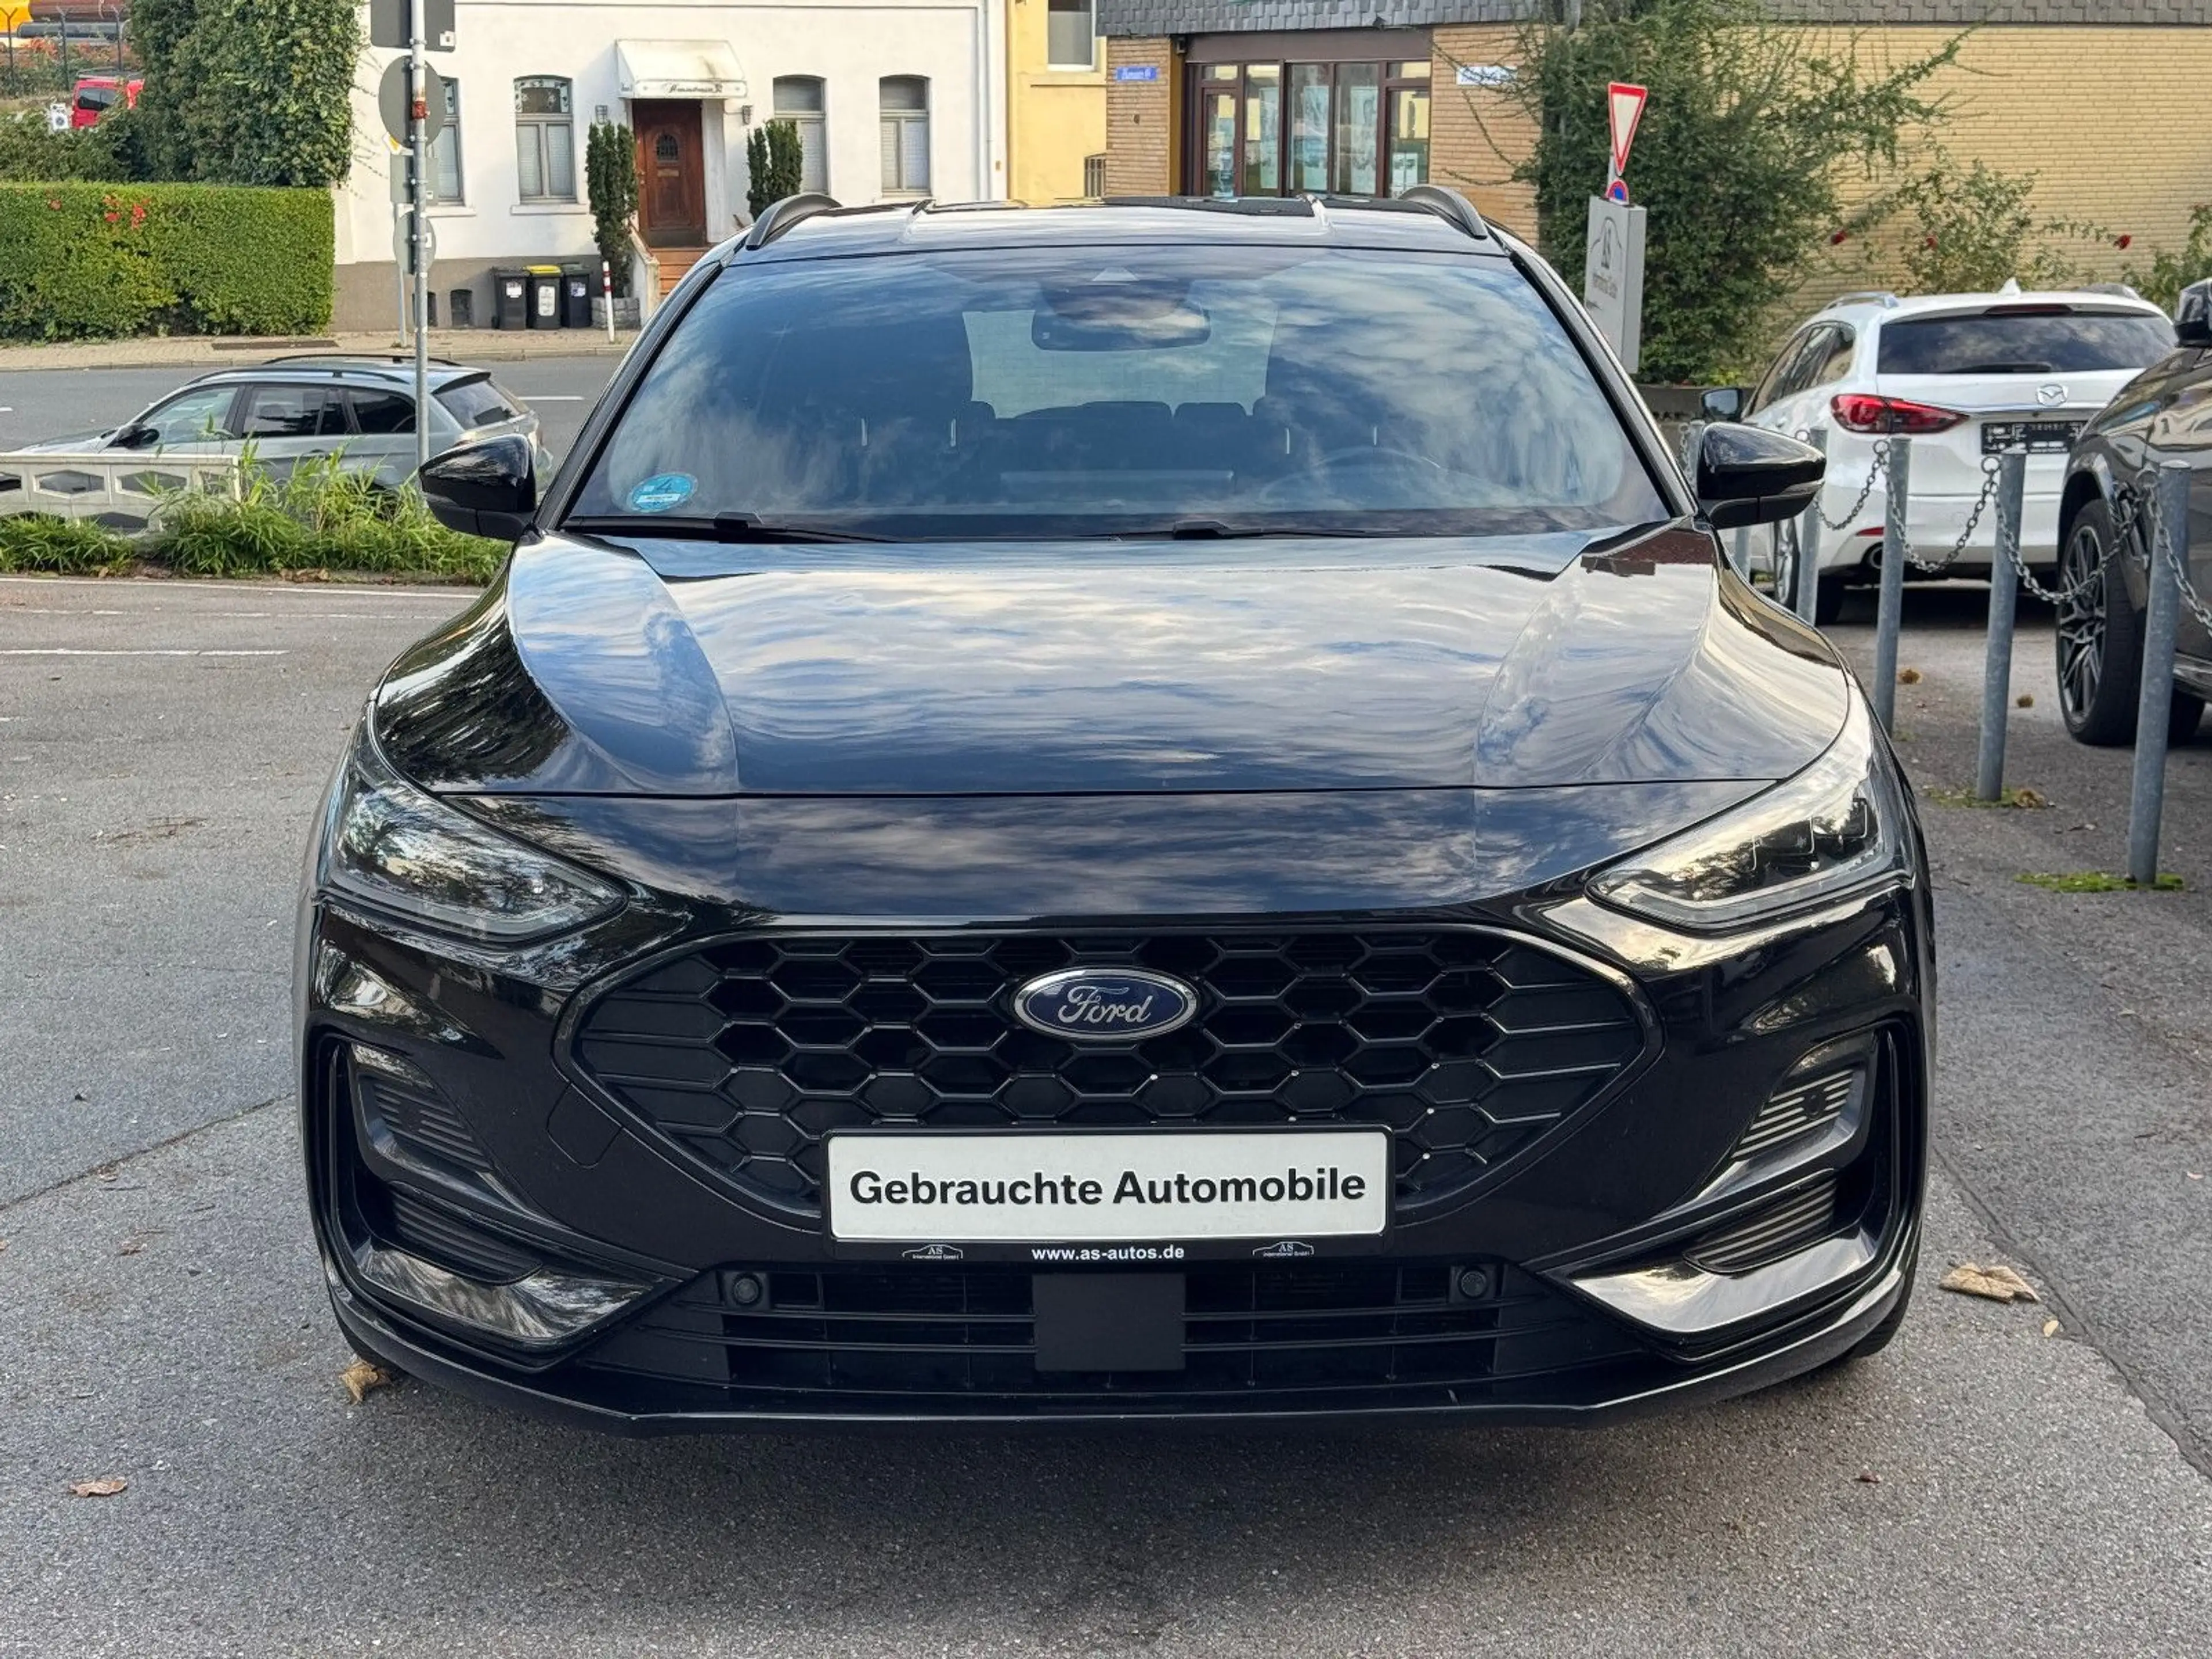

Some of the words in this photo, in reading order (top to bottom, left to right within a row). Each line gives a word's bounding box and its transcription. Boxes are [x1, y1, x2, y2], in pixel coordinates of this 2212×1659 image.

[1058, 986, 1153, 1023] Ford
[850, 1171, 1103, 1205] Gebrauchte
[1113, 1168, 1366, 1204] Automobile
[1031, 1244, 1184, 1260] www.as-autos.de
